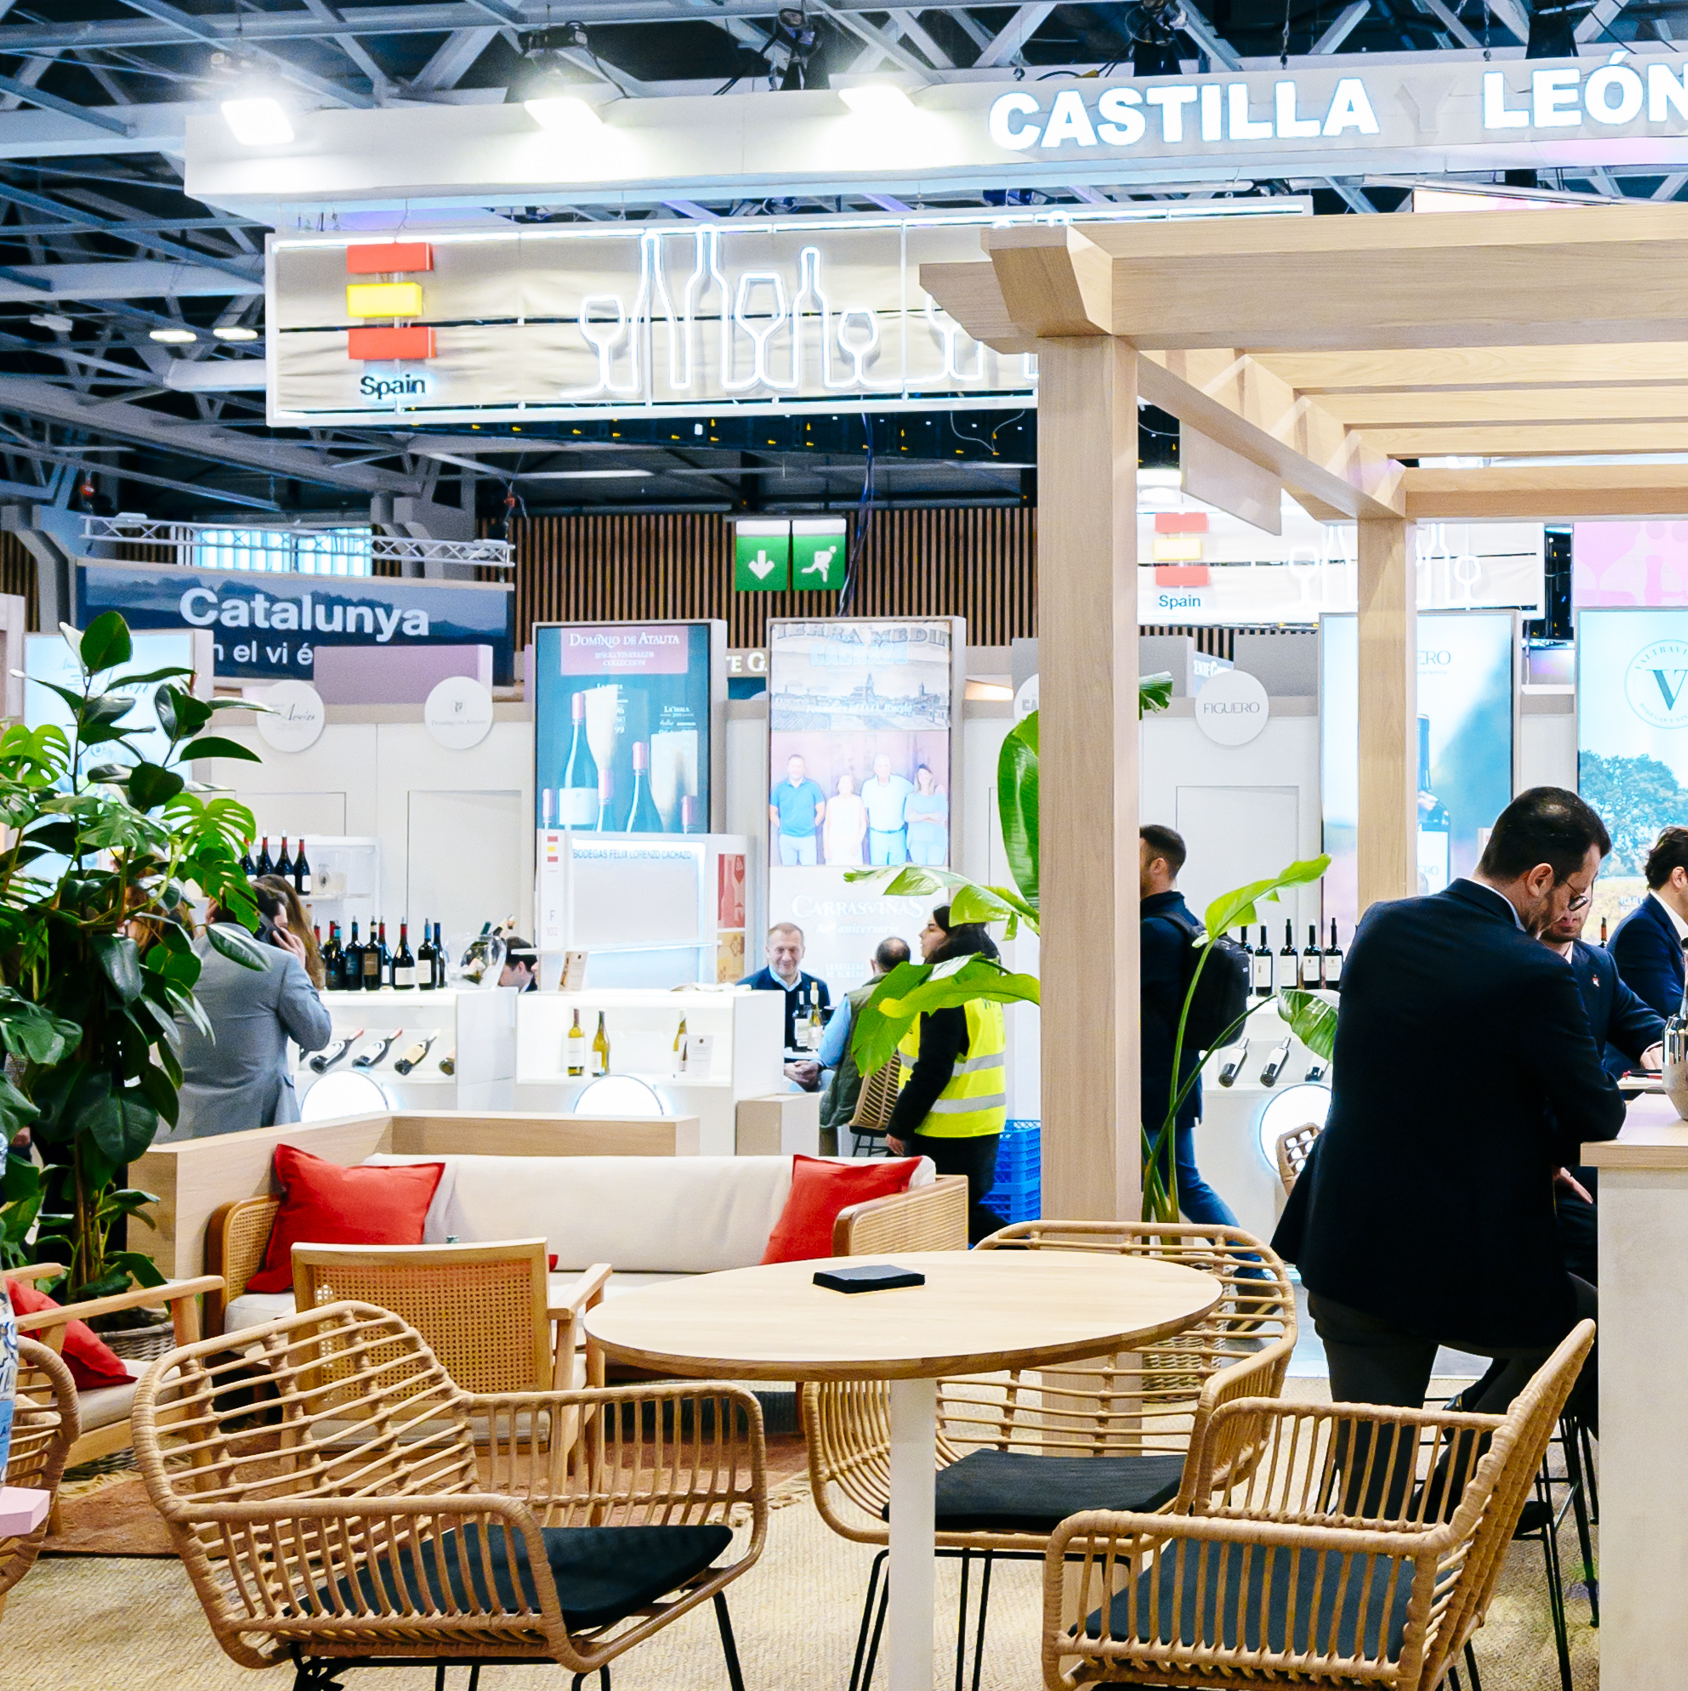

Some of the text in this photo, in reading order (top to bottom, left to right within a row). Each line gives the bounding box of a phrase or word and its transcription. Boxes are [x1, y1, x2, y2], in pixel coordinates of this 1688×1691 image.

[987, 76, 1380, 152] CASTILLA
[358, 372, 428, 400] Spain
[179, 586, 430, 643] Catalunya
[1158, 593, 1202, 610] Spain
[233, 639, 257, 663] el
[266, 641, 288, 665] vi
[1203, 702, 1261, 715] FIGUERO
[572, 848, 608, 860] BODEGAS
